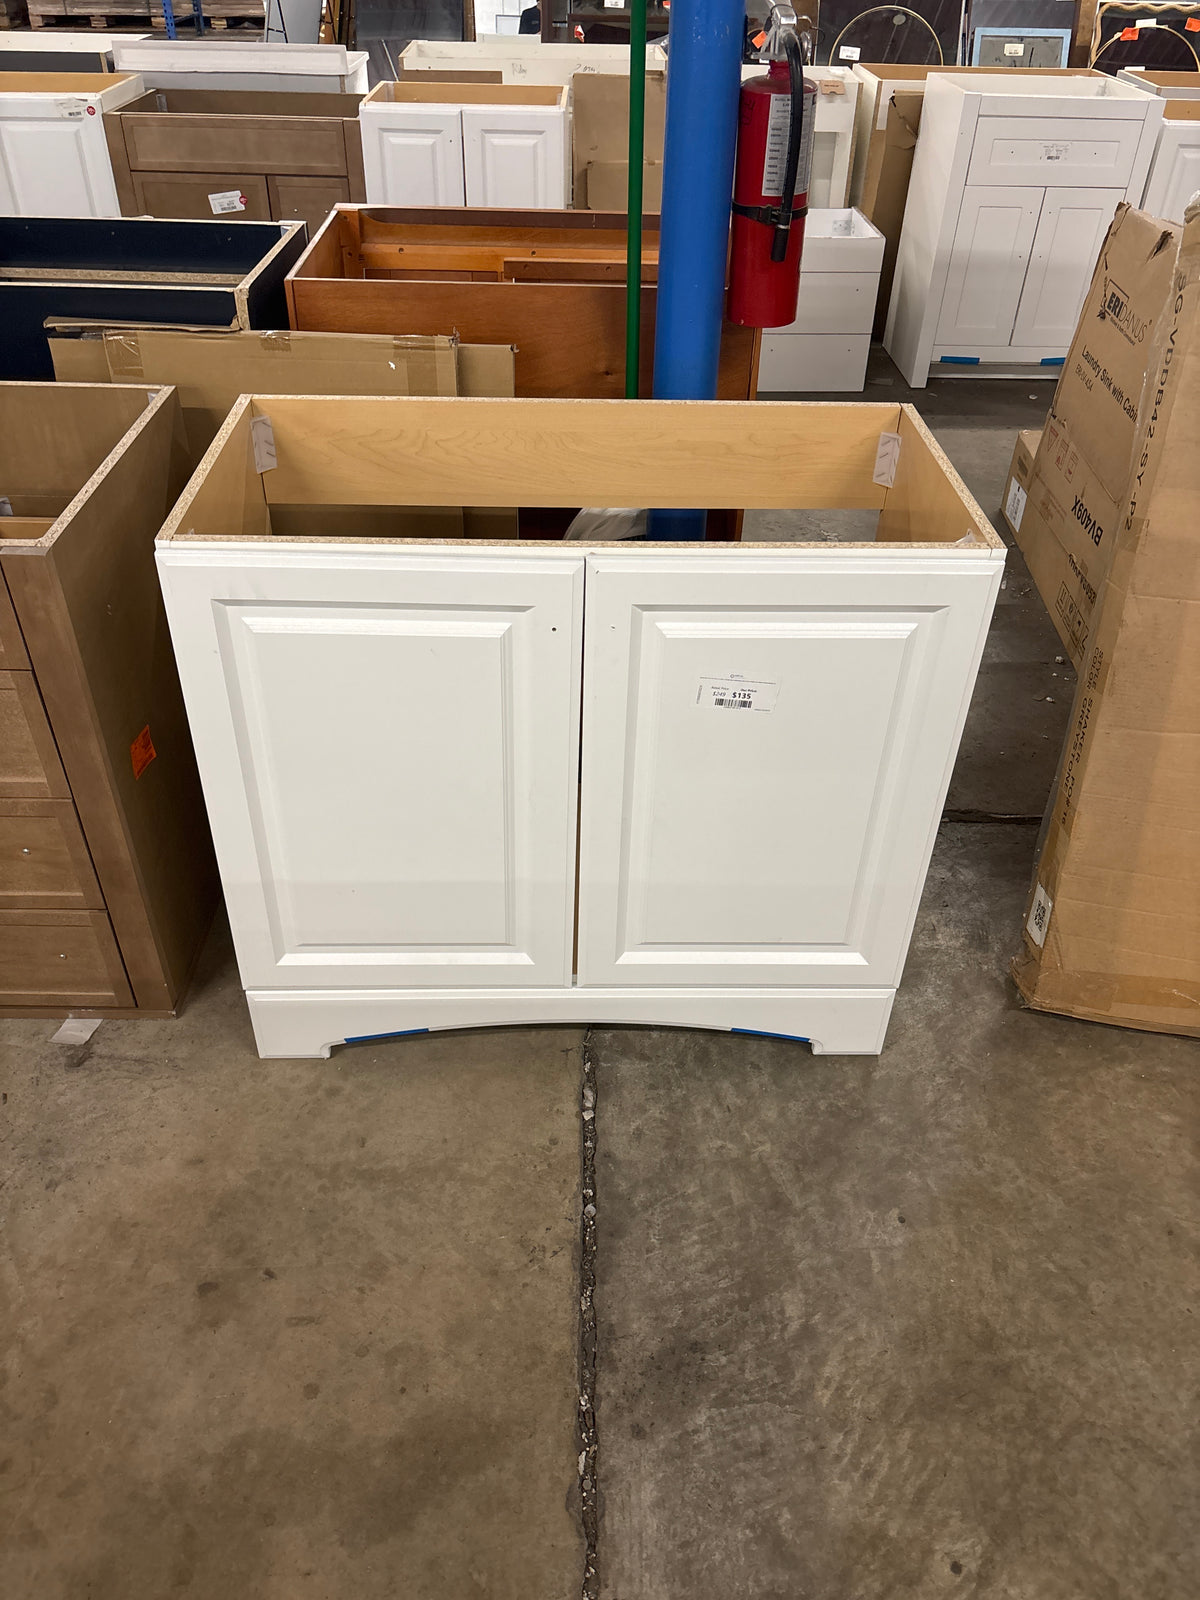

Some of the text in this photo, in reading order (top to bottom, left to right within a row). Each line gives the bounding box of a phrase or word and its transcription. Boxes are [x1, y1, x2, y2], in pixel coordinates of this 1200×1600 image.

[1107, 291, 1147, 343] ERIDANUS
[1081, 344, 1101, 378] Laundry
[1100, 368, 1114, 392] Sink
[1111, 384, 1124, 405] with
[1071, 494, 1104, 547] BV409X
[732, 691, 752, 700] $135
[1091, 649, 1104, 690] STYLE
[1063, 646, 1100, 793] COLOR GREYSTONE
[1075, 697, 1093, 764] SHAKER
